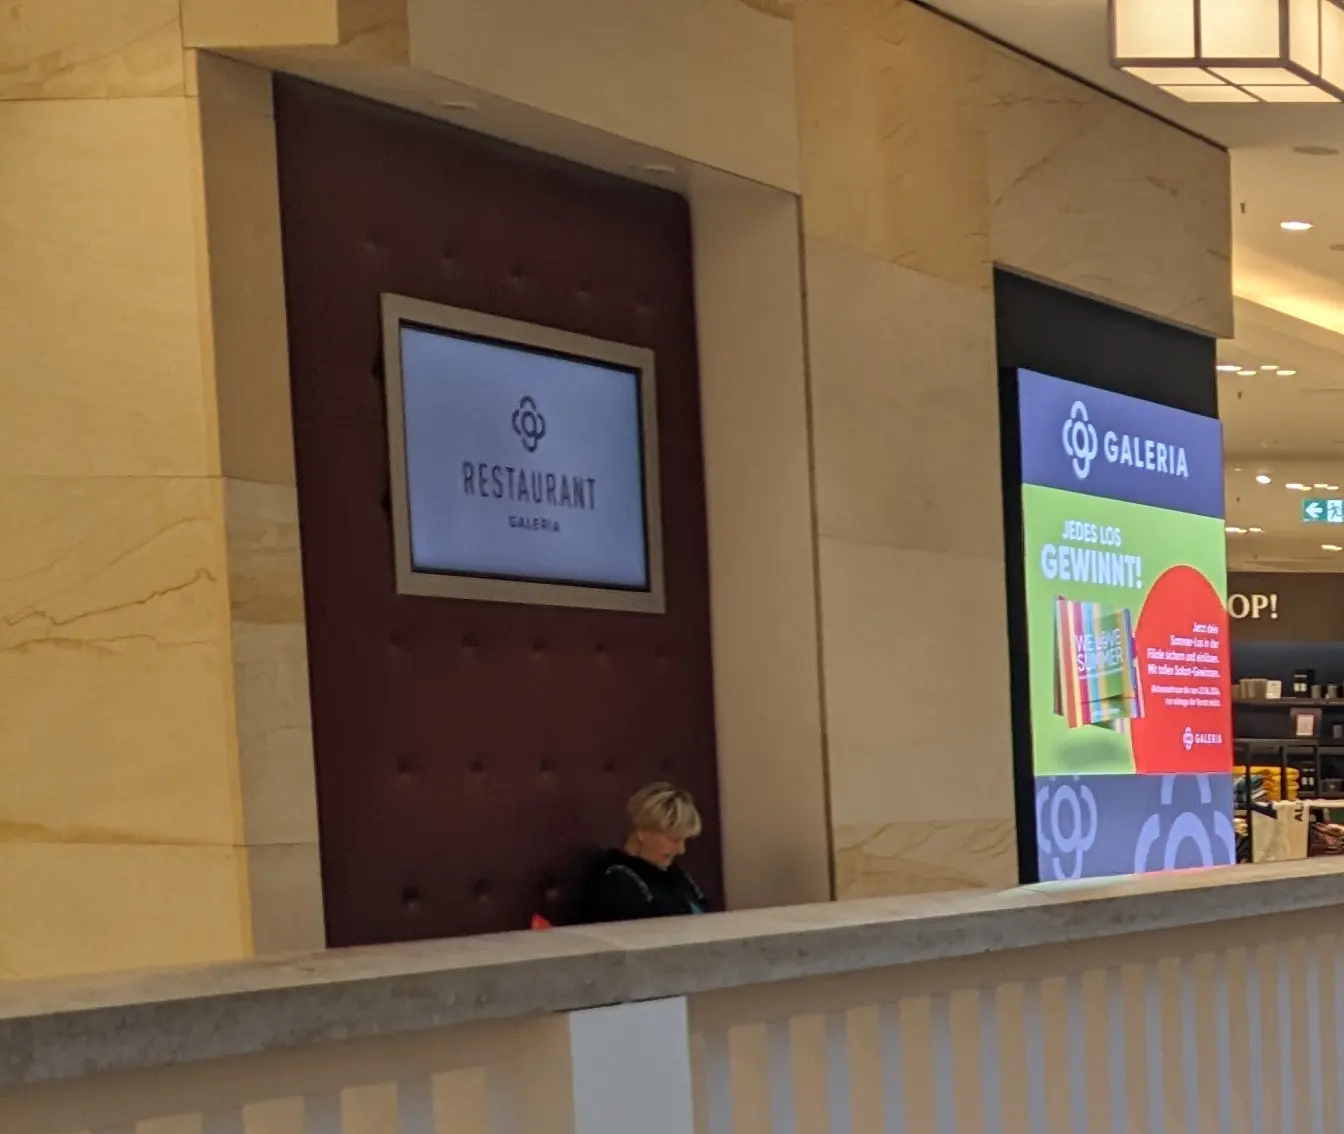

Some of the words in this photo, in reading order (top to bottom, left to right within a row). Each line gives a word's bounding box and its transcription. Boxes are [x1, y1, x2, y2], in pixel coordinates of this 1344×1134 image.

[1103, 431, 1190, 478] GALERIA
[462, 460, 596, 510] RESTAURANT
[508, 515, 560, 533] GALERIA
[1061, 519, 1098, 544] JEDES
[1099, 526, 1121, 547] LOS
[1040, 543, 1143, 589] GEWINNT!
[1195, 733, 1223, 744] GALERIA
